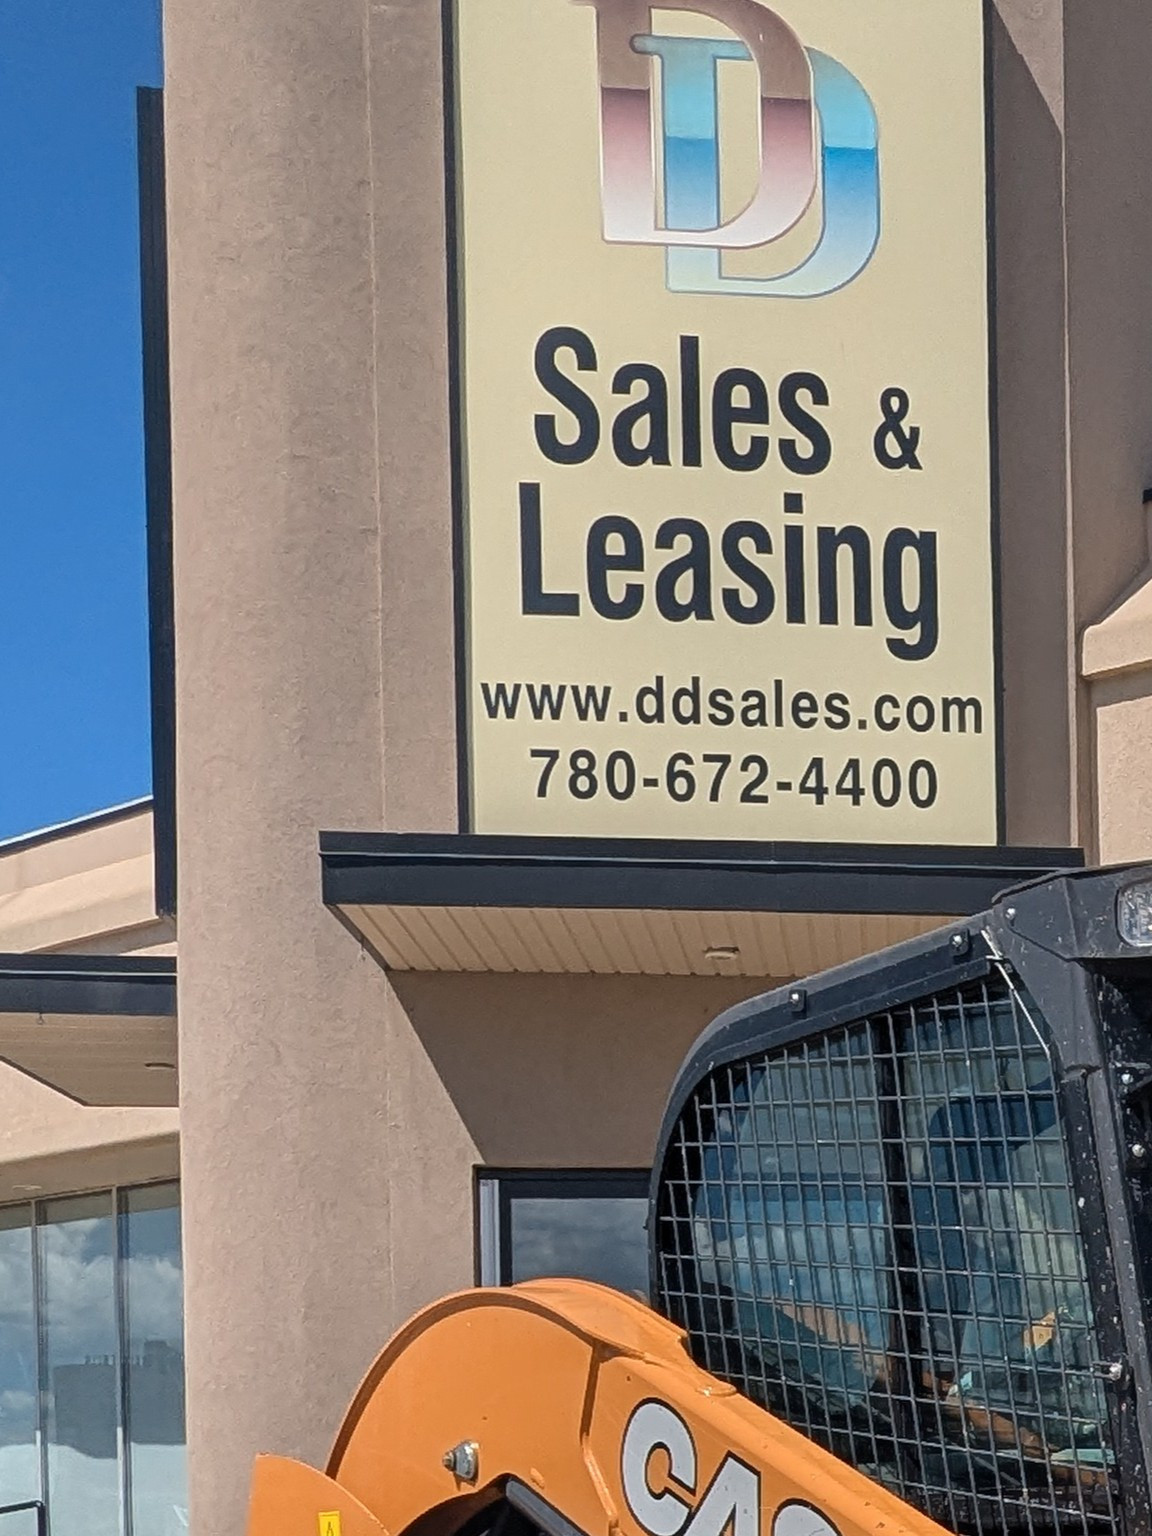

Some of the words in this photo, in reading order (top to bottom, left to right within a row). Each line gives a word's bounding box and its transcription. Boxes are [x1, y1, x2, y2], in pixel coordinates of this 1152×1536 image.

[533, 326, 832, 476] Sales
[874, 386, 922, 471] &
[519, 482, 939, 660] Leasing
[480, 677, 984, 735] www.ddsales.com
[530, 750, 938, 808] 780-672-4400
